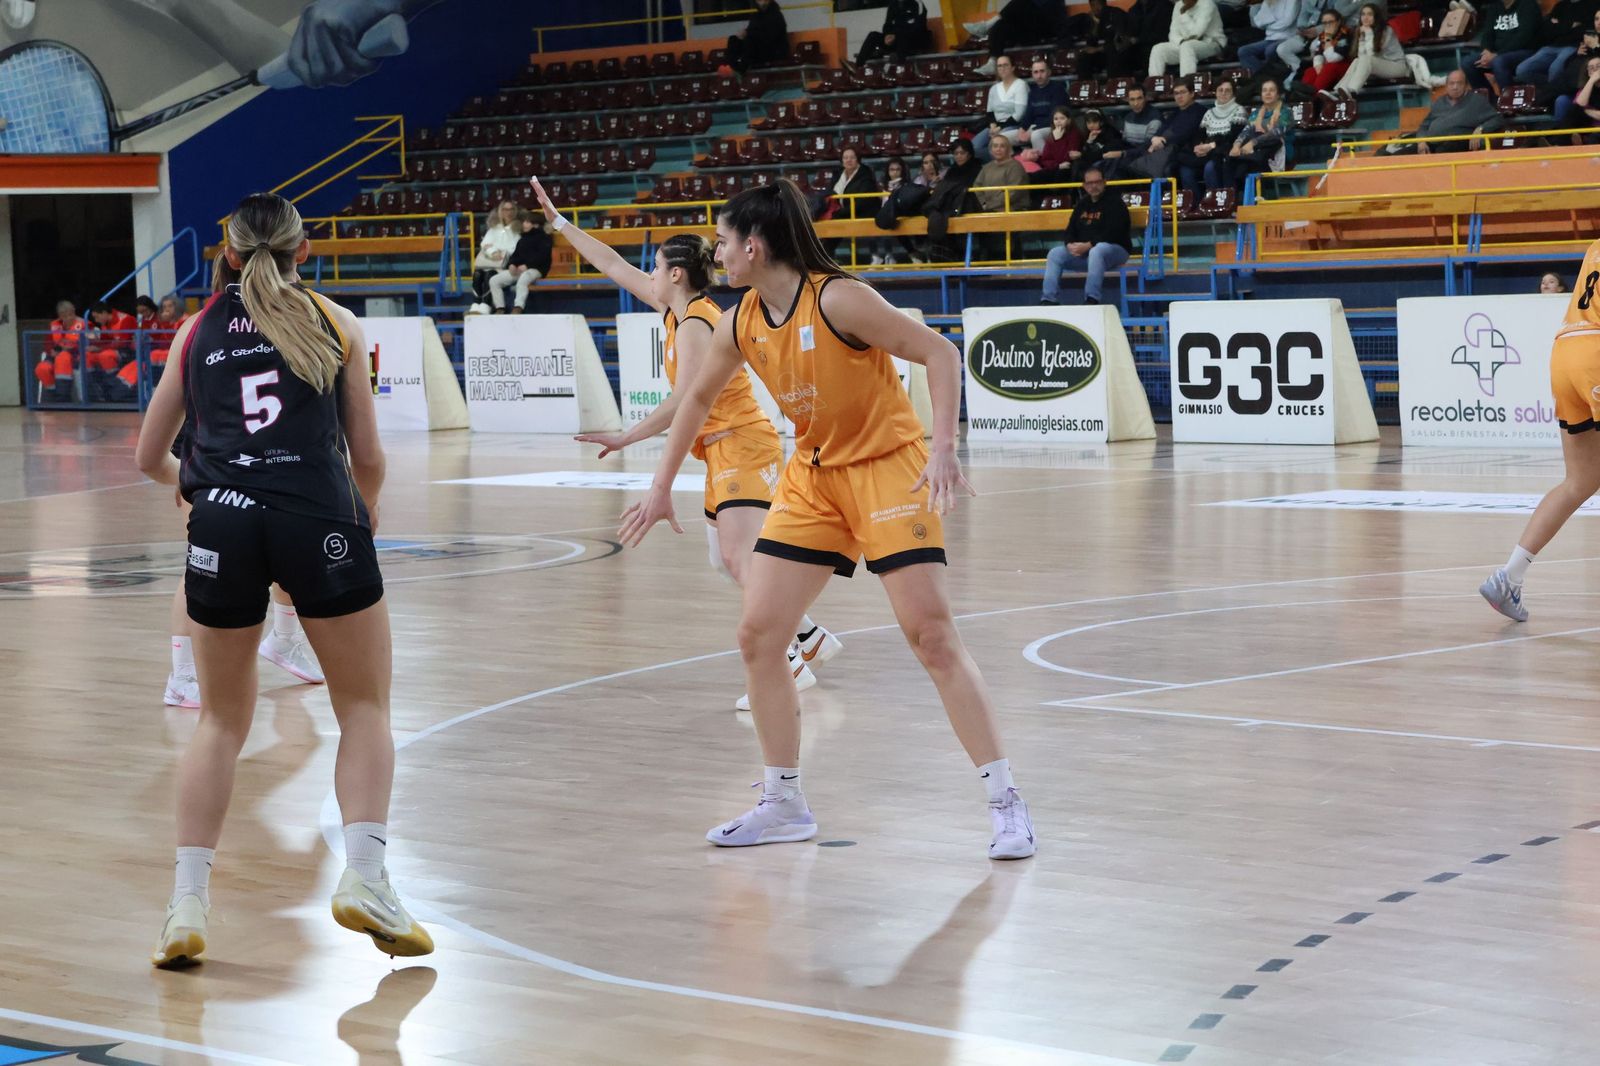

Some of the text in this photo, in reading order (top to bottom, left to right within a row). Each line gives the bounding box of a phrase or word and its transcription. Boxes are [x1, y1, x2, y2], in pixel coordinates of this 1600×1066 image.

[468, 349, 575, 377] RESTAURANTE
[981, 339, 1093, 377] Paulino Iglesias
[381, 376, 421, 385] DE LA LUZ
[1178, 332, 1325, 415] G3C
[469, 380, 525, 400] MARTA
[1000, 380, 1033, 388] Embutidos
[1039, 380, 1069, 388] Jamones
[241, 370, 282, 435] 5
[1178, 404, 1223, 415] GIMNASIO
[1277, 405, 1325, 416] CRUCES
[1411, 398, 1507, 423] recoletas
[971, 414, 1104, 435] www.paulinoiglesias.com
[1512, 431, 1560, 439] PERSONA
[265, 455, 301, 464] INTERBUS
